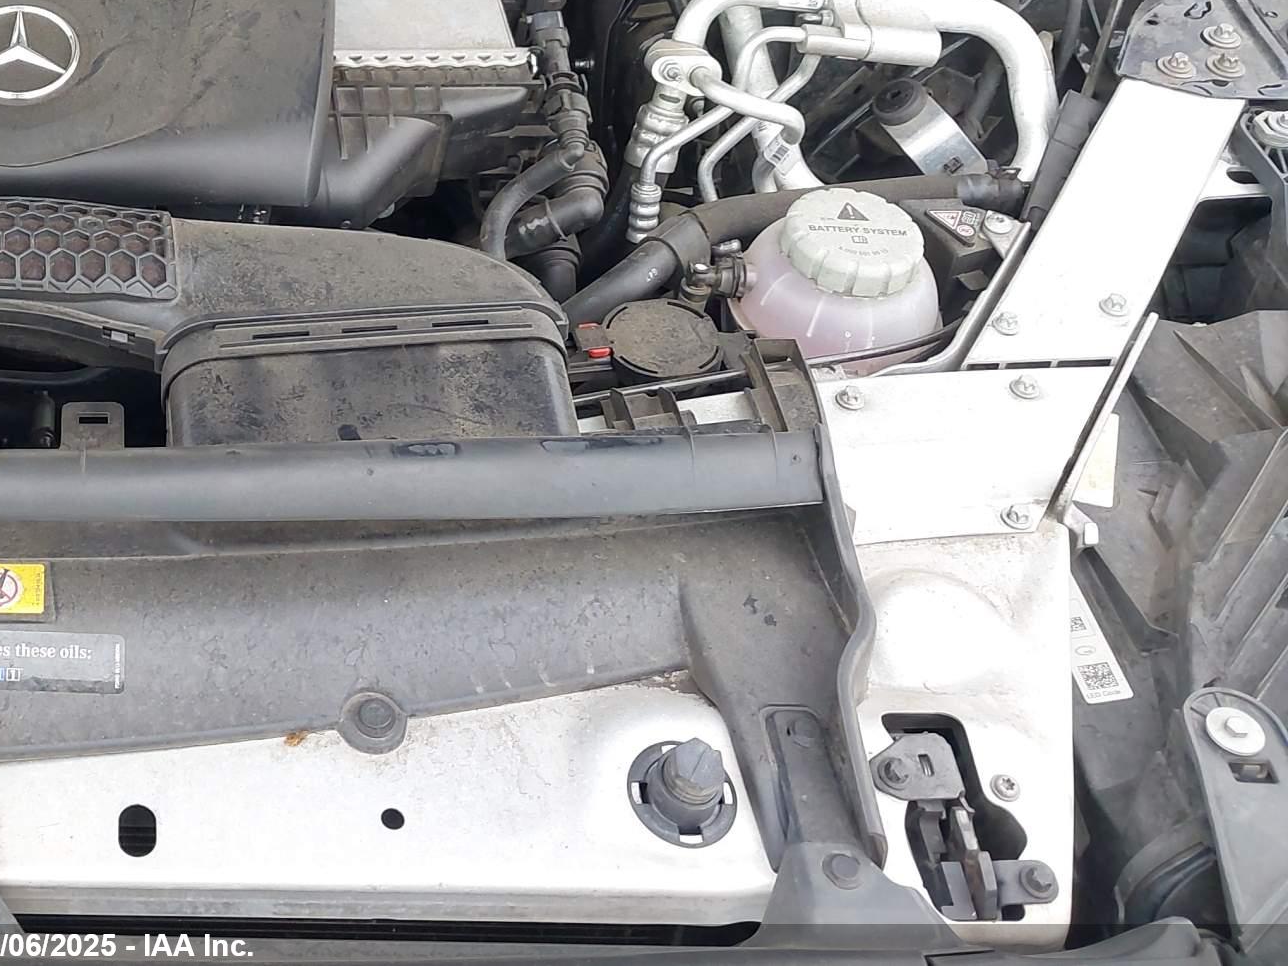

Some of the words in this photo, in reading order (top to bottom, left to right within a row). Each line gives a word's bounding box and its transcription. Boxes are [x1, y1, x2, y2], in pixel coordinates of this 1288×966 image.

[808, 224, 859, 234] BATTERY
[863, 228, 908, 236] SYSTEM
[15, 643, 56, 659] these
[60, 644, 92, 660] oils:
